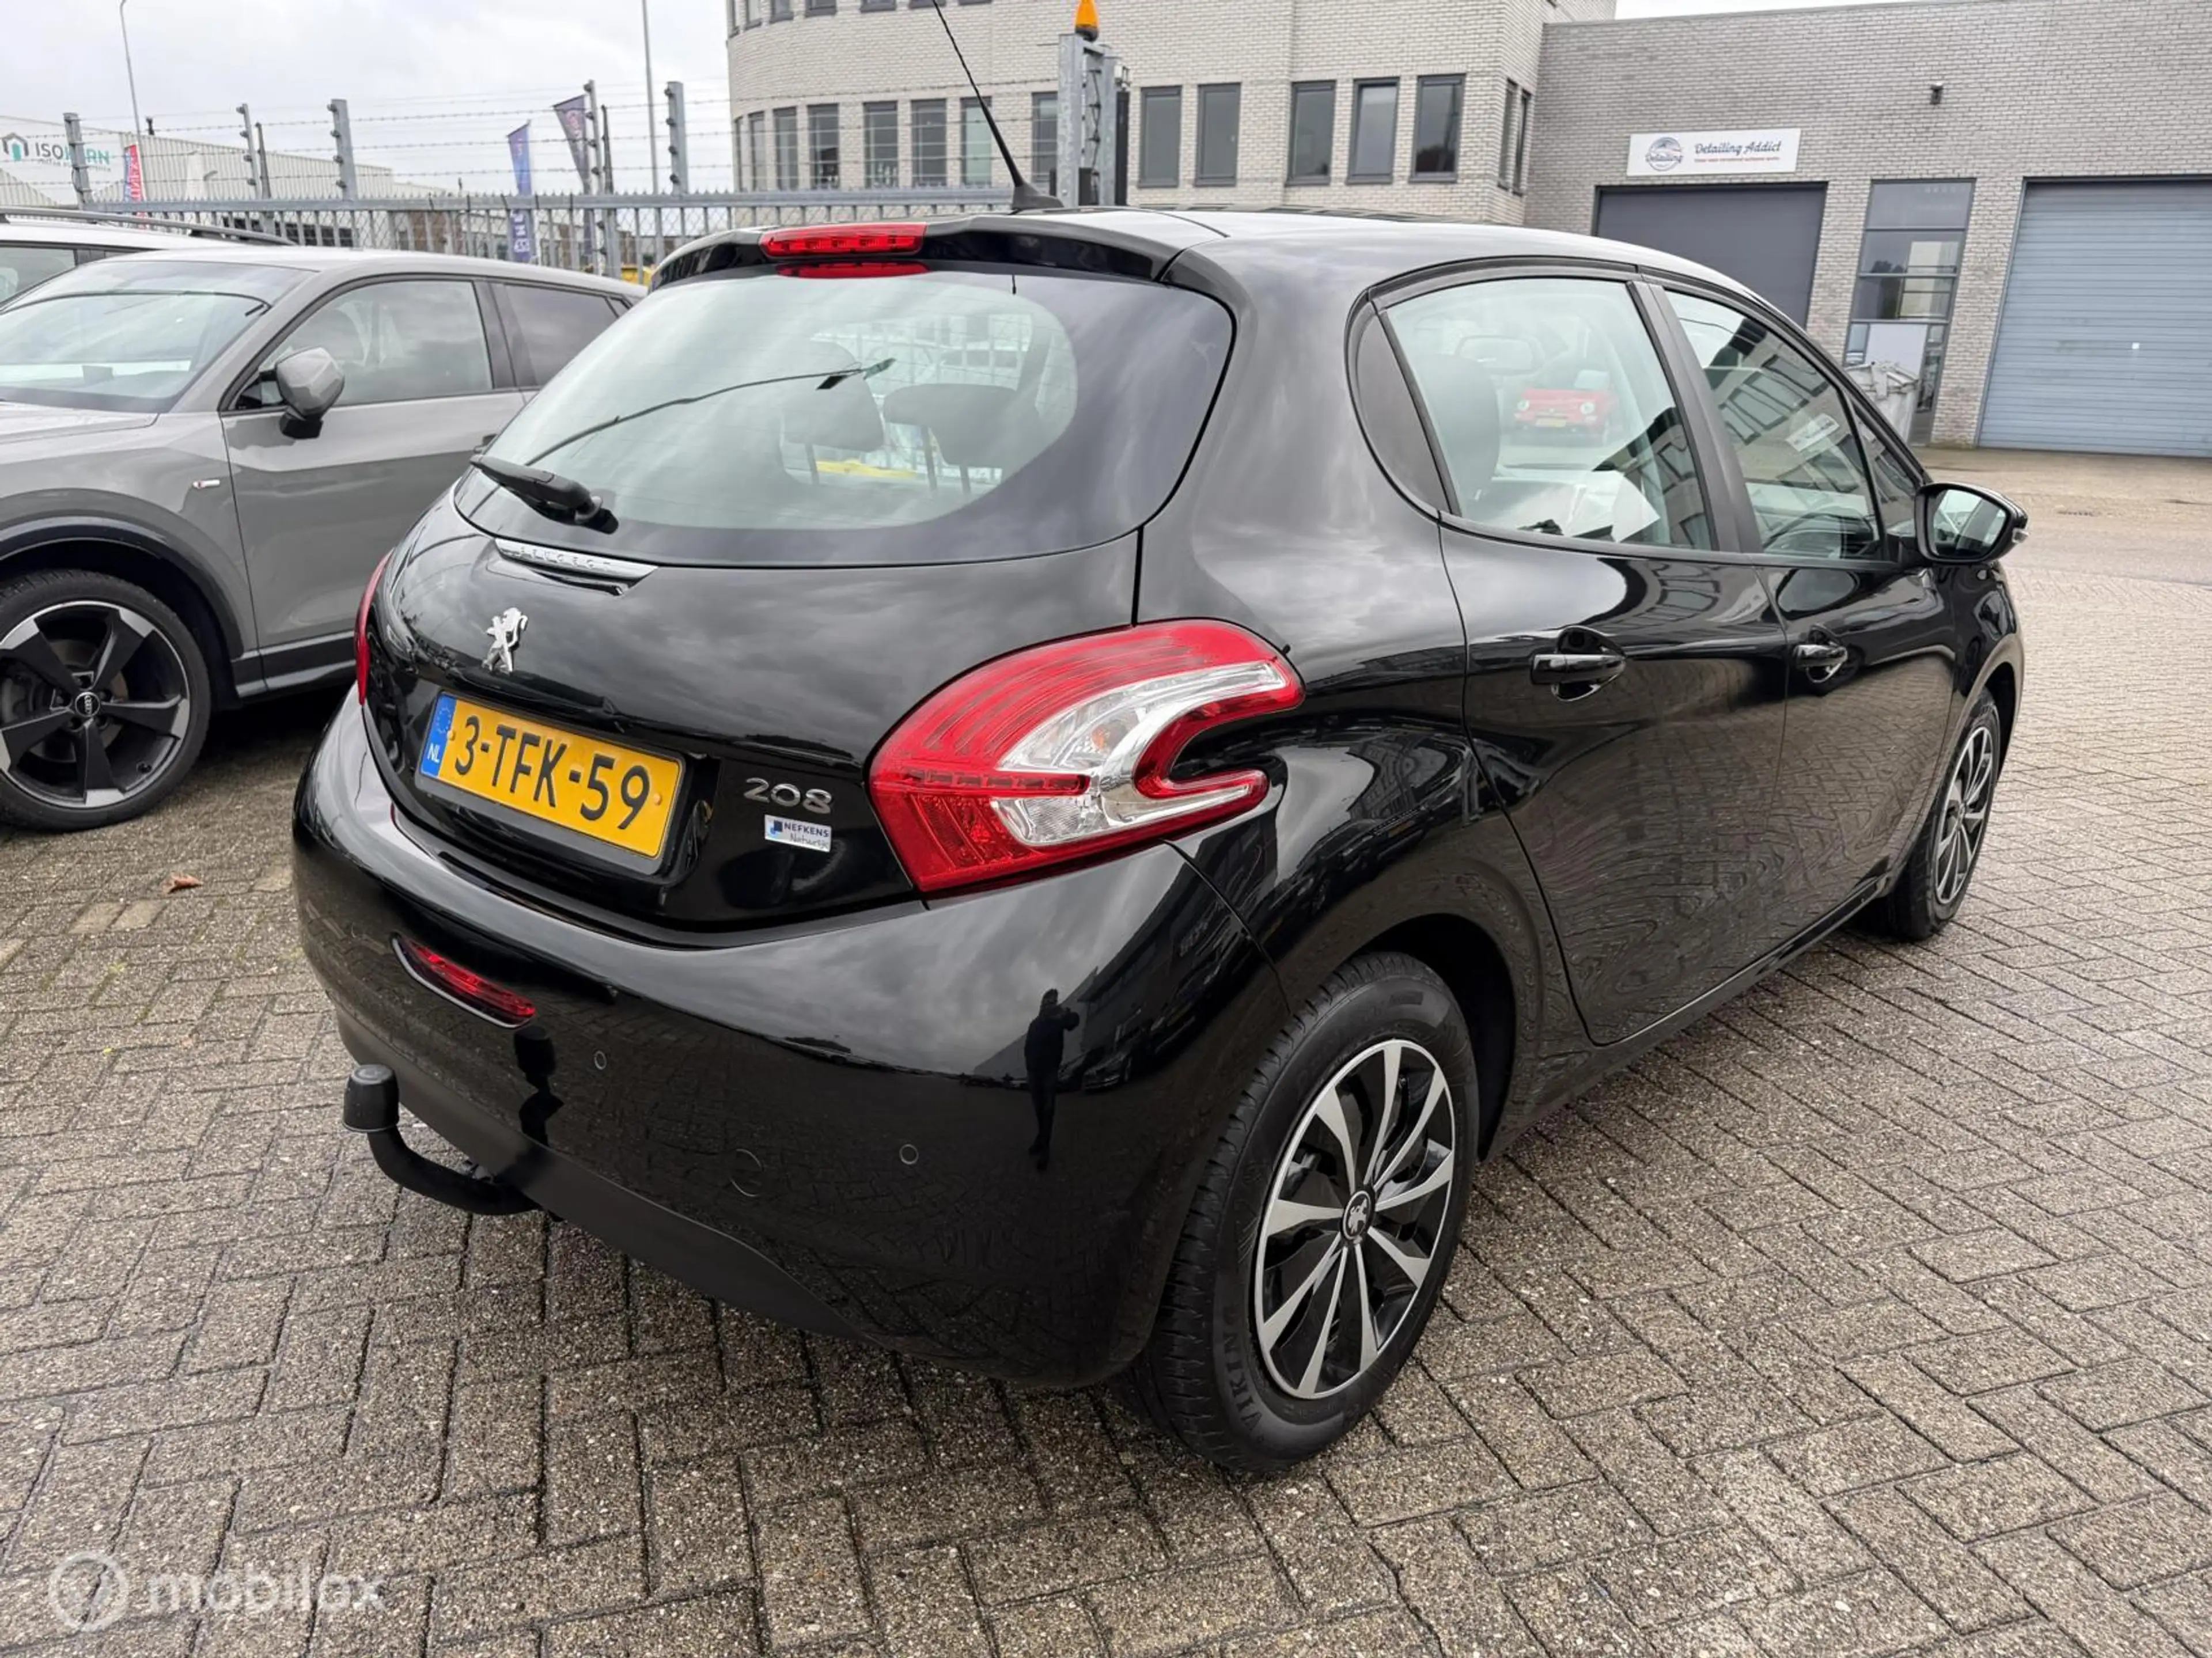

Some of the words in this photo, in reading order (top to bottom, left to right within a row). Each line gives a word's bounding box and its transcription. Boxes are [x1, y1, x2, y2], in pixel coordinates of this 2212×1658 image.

[1695, 142, 1743, 155] Detailing
[1744, 141, 1782, 155] Addict
[427, 742, 441, 763] NL
[454, 715, 650, 830] 3-TFK-59
[743, 777, 832, 814] 208
[784, 822, 830, 837] NEFKENS
[1222, 1305, 1263, 1431] VIKING
